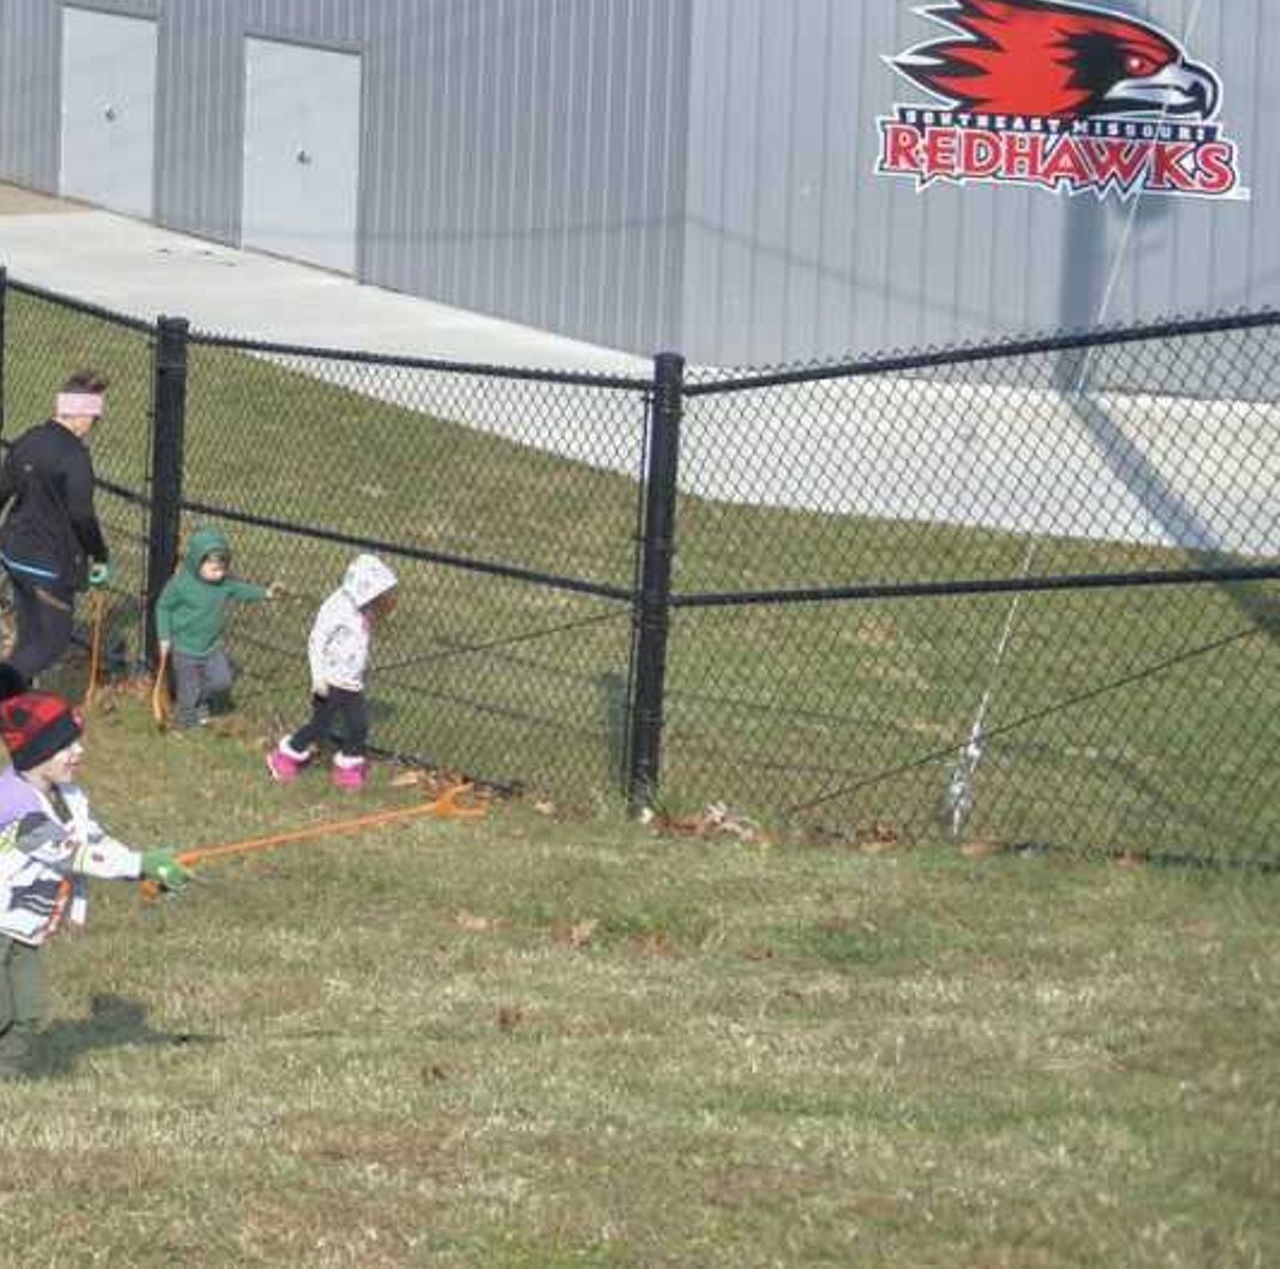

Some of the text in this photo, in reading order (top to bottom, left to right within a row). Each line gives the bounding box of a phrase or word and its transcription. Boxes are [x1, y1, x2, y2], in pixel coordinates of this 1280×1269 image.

[905, 109, 1207, 141] SOUTHEAST MISSOURI
[881, 124, 1240, 195] REDHAWKS
